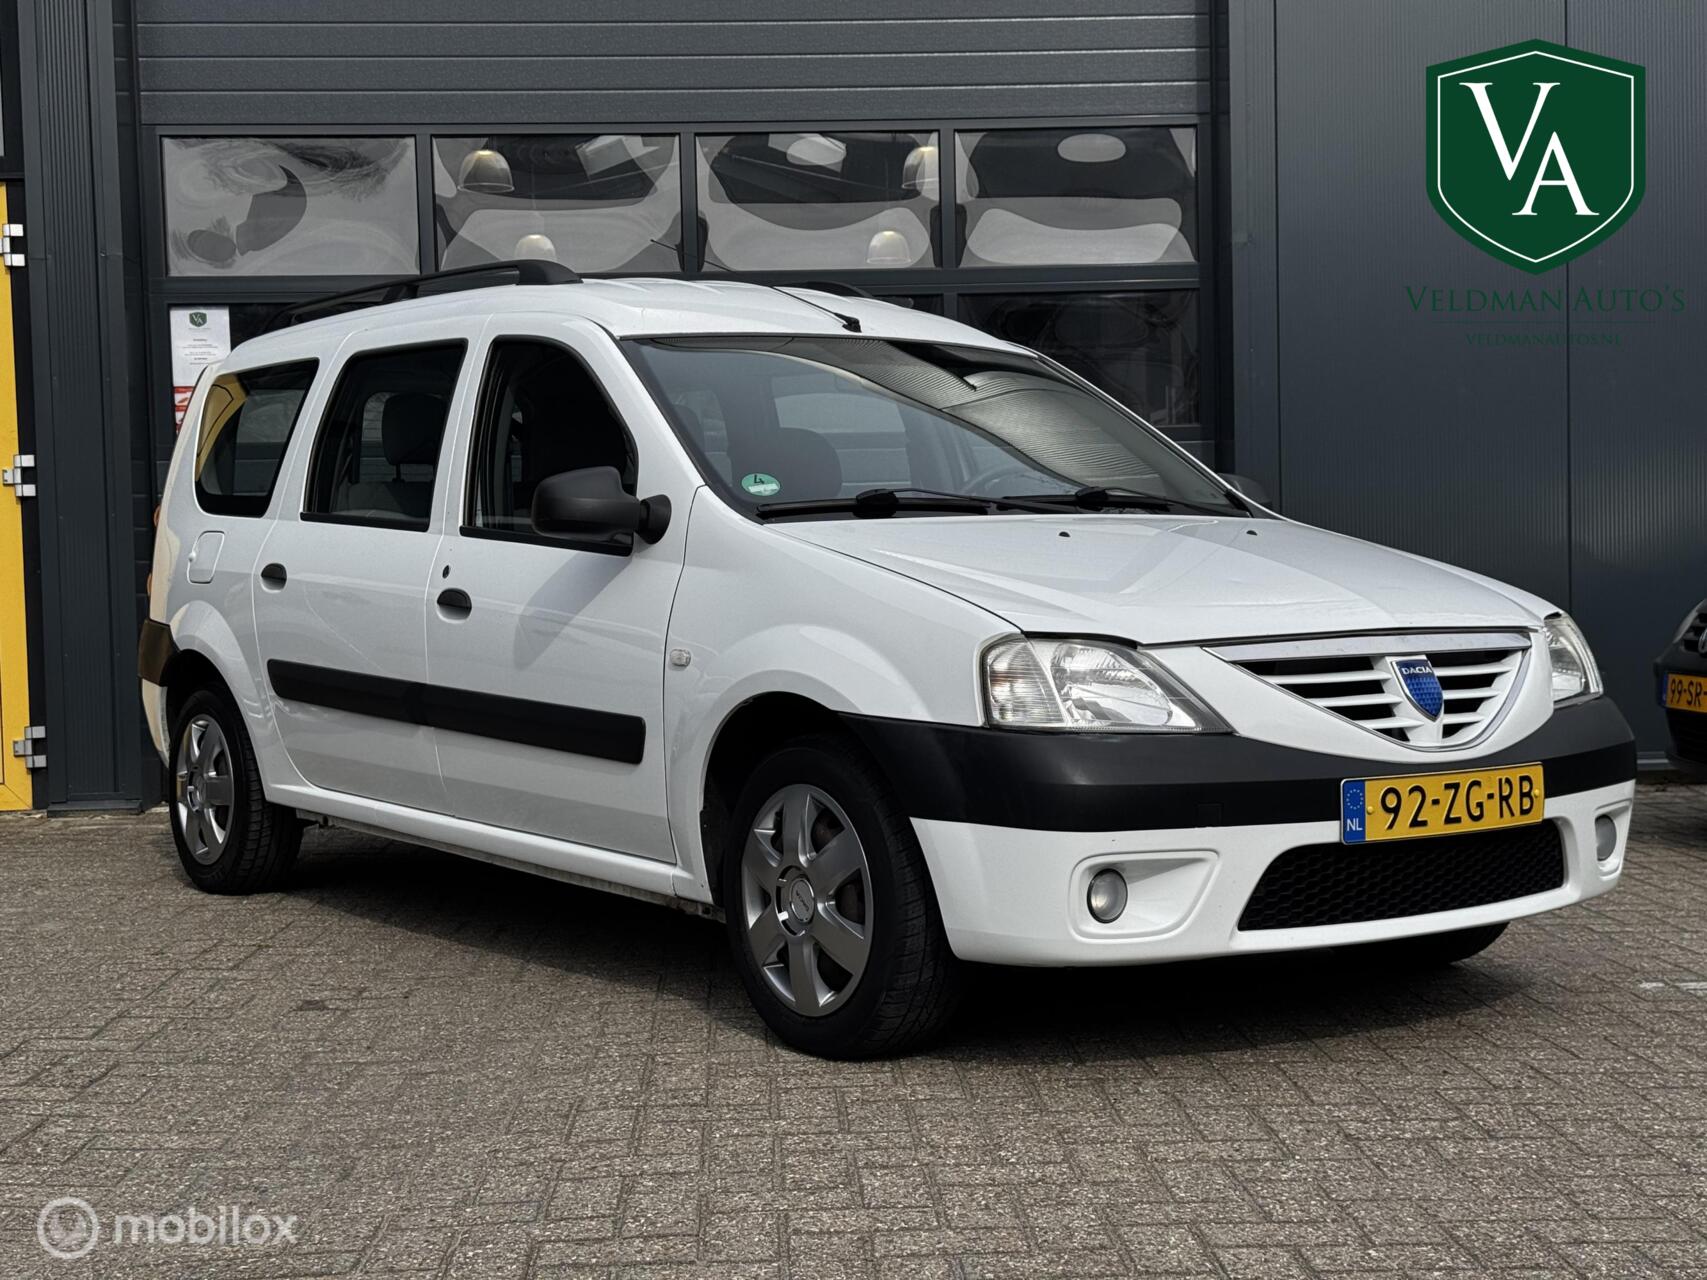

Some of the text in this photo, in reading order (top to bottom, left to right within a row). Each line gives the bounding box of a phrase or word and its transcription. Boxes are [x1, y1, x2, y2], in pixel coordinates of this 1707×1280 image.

[1401, 665, 1433, 675] DACIA
[1380, 774, 1535, 831] 92-ZG-RB
[1346, 818, 1363, 831] NL
